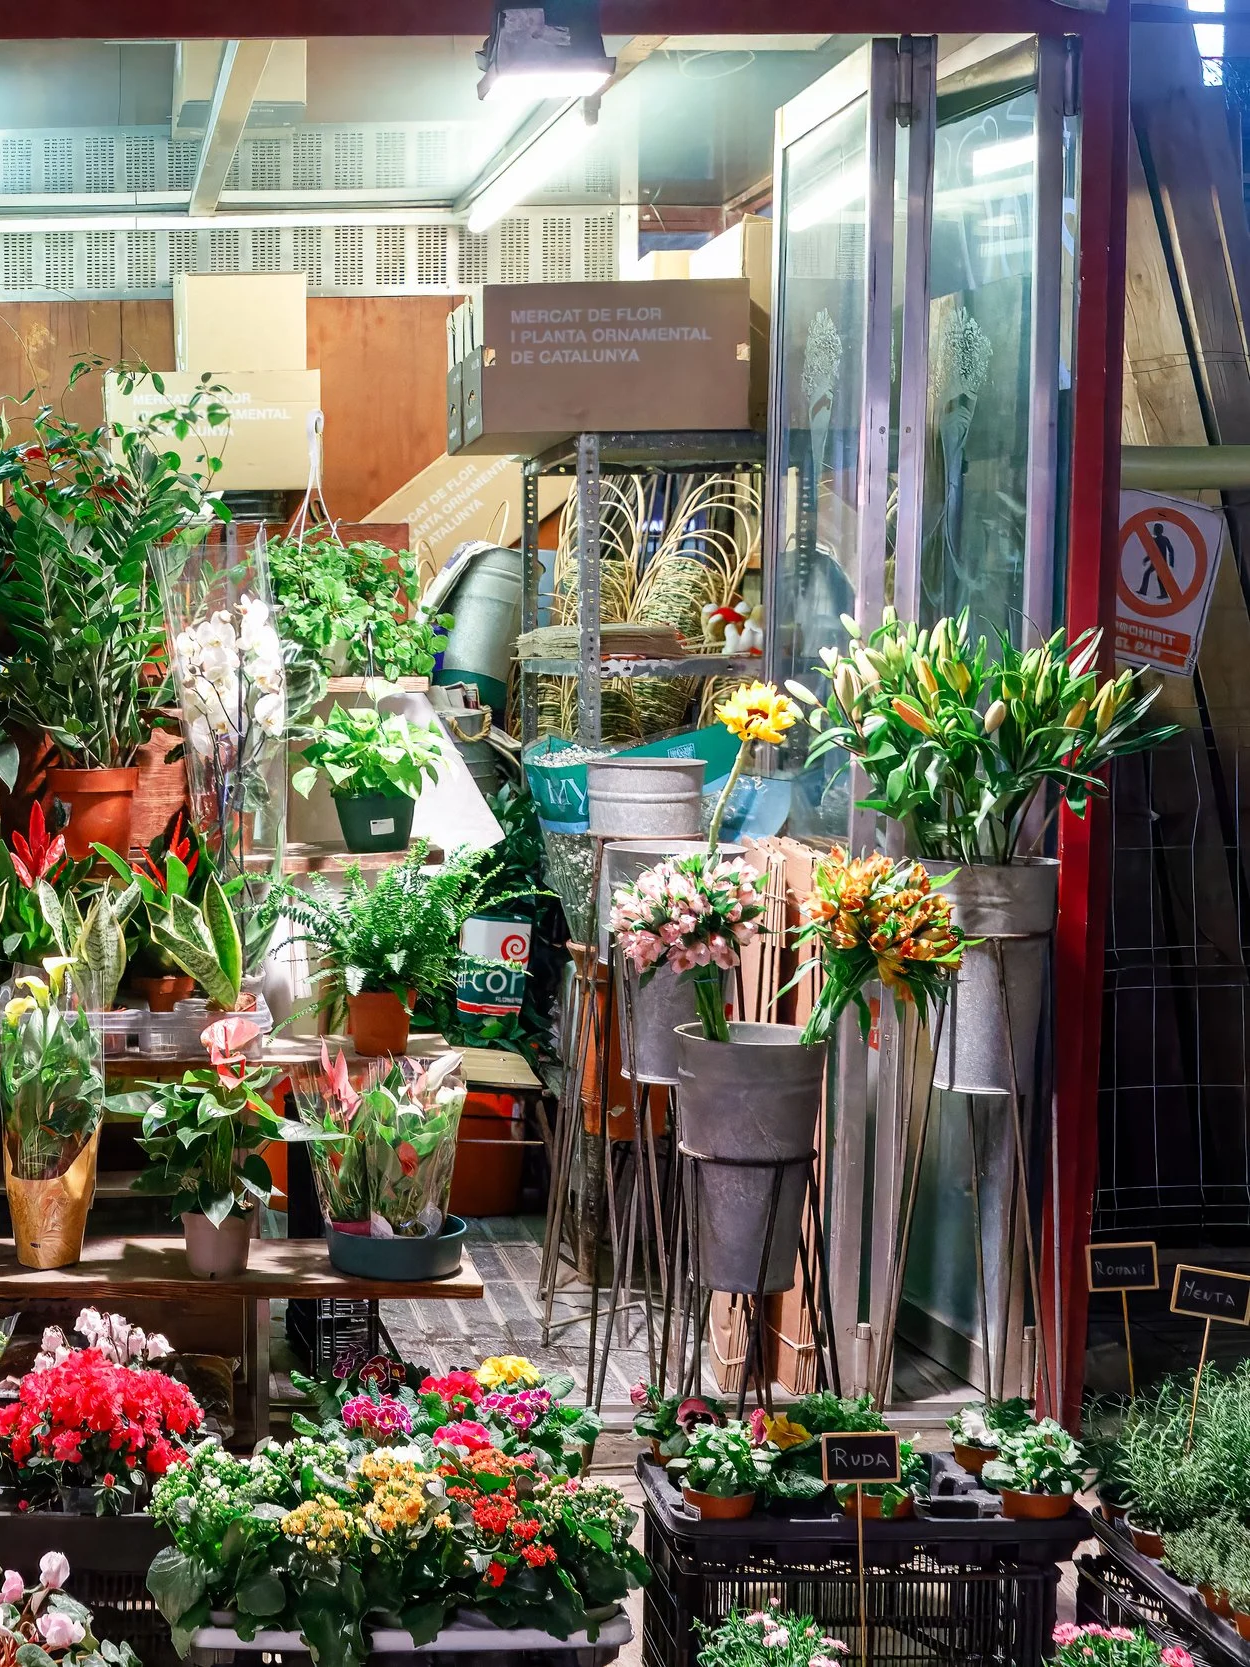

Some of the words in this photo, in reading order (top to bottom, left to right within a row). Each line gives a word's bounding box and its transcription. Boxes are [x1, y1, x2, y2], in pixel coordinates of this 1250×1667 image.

[511, 309, 582, 324] MERCAT
[588, 308, 611, 322] DE
[617, 307, 662, 321] FLOR
[511, 330, 516, 343] I
[521, 329, 587, 344] PLANTA
[592, 327, 712, 343] ORNAMENTAL
[511, 351, 534, 365] DE
[539, 348, 640, 364] CATALUNYA
[133, 393, 188, 406] MERCAT
[429, 488, 448, 505] DE
[446, 463, 478, 492] FLOR
[1183, 1281, 1236, 1307] MENTA
[831, 1447, 890, 1468] RUDA
